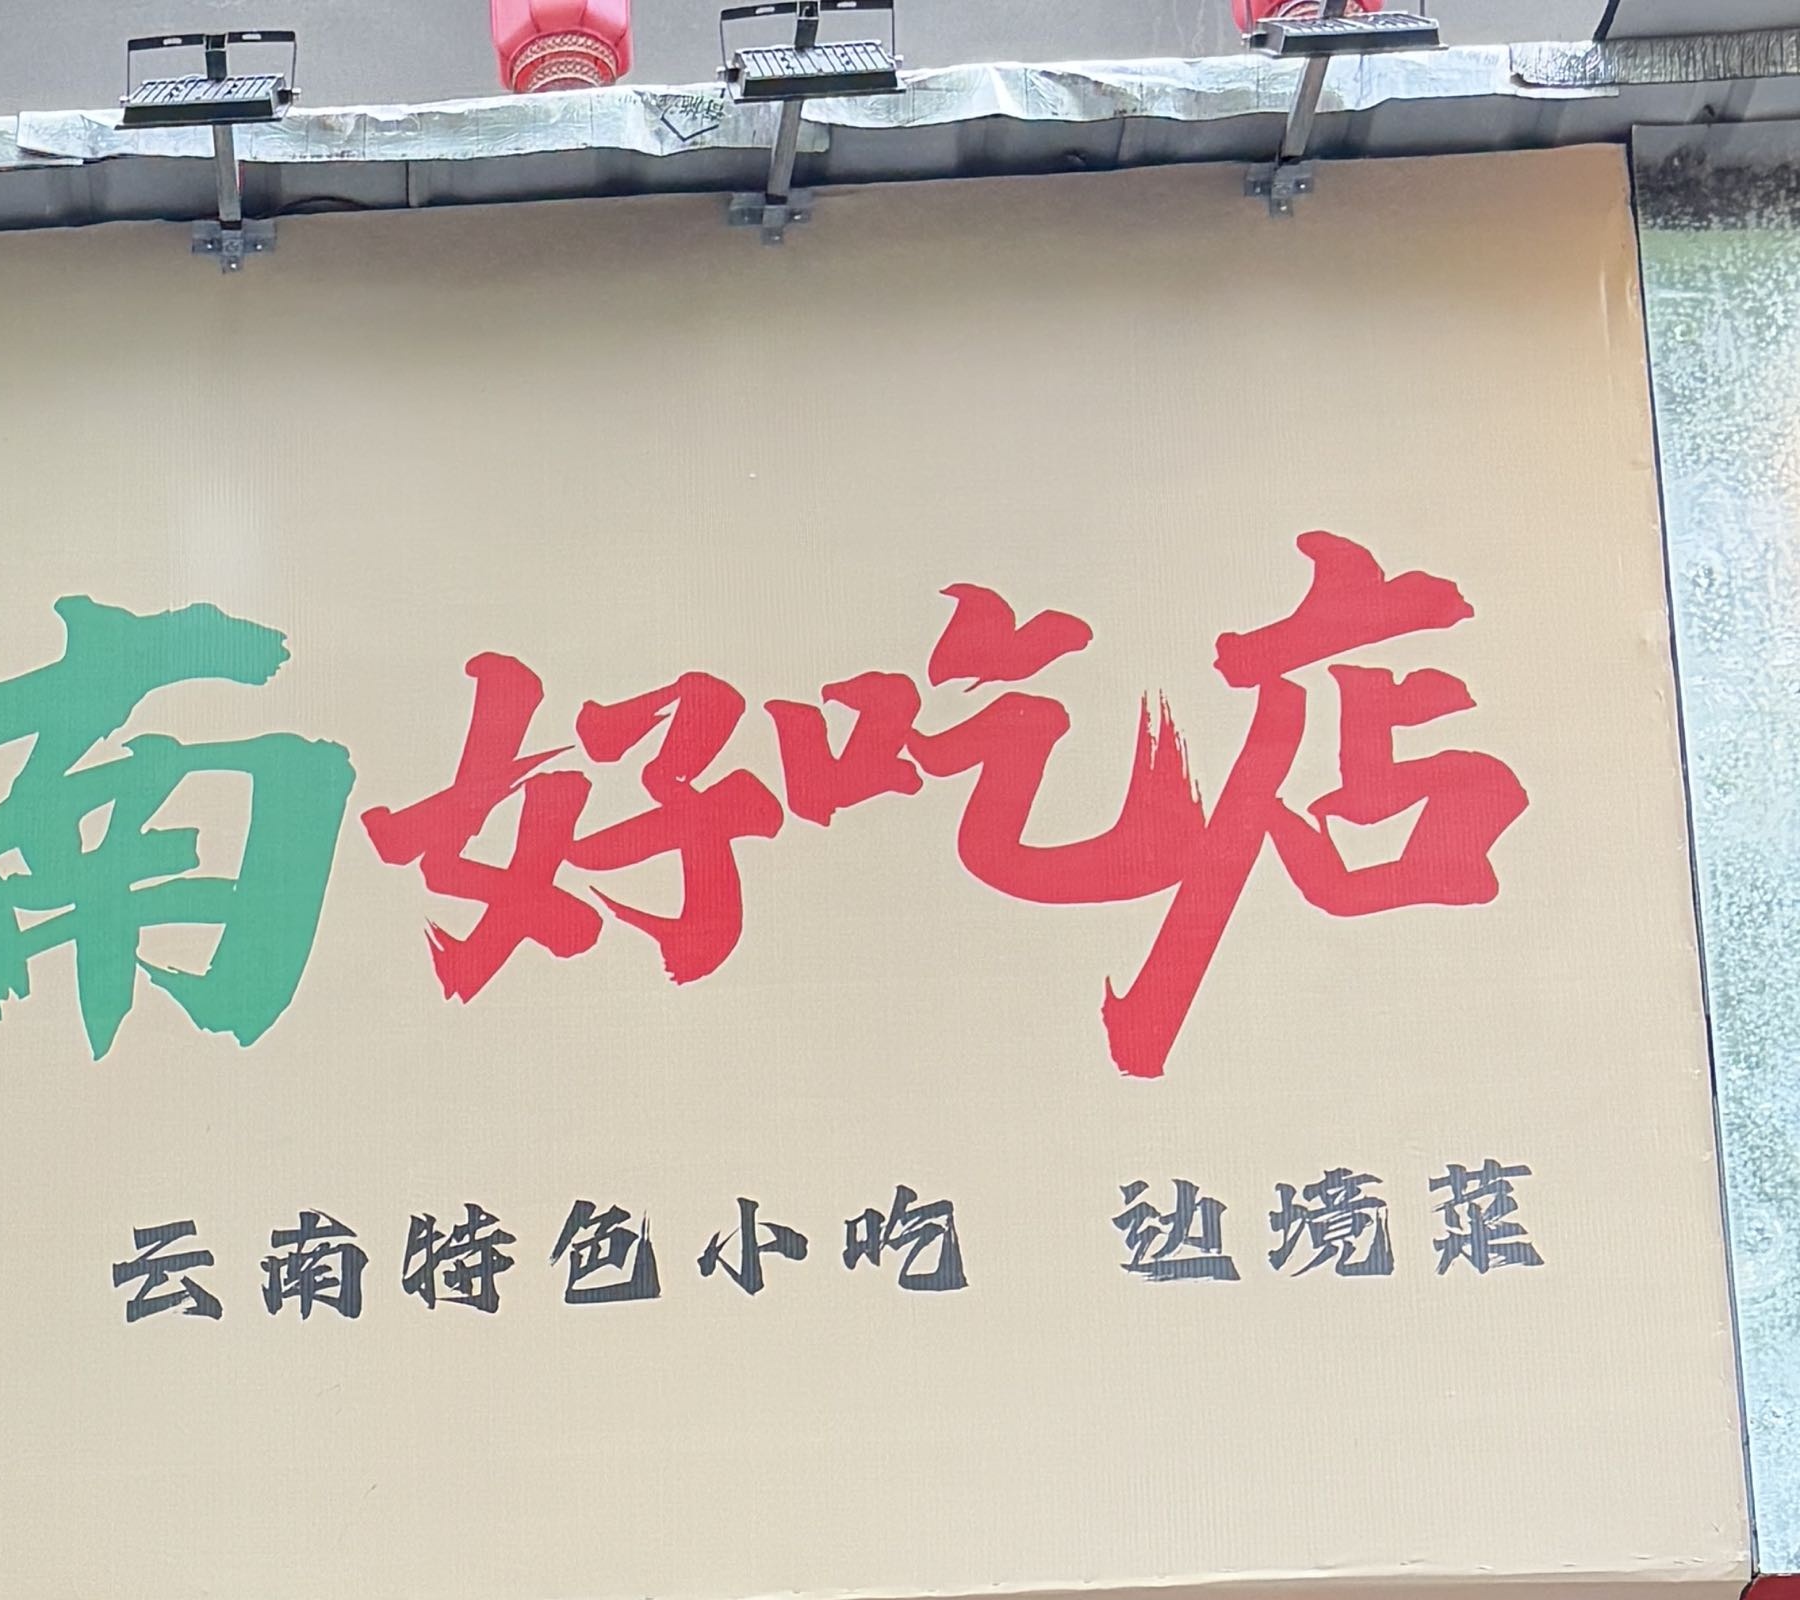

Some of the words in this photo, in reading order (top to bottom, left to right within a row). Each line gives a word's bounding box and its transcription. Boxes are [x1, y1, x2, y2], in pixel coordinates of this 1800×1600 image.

[110, 1184, 969, 1322] 云南特色小吃
[1119, 1158, 1547, 1284] 边境菜
